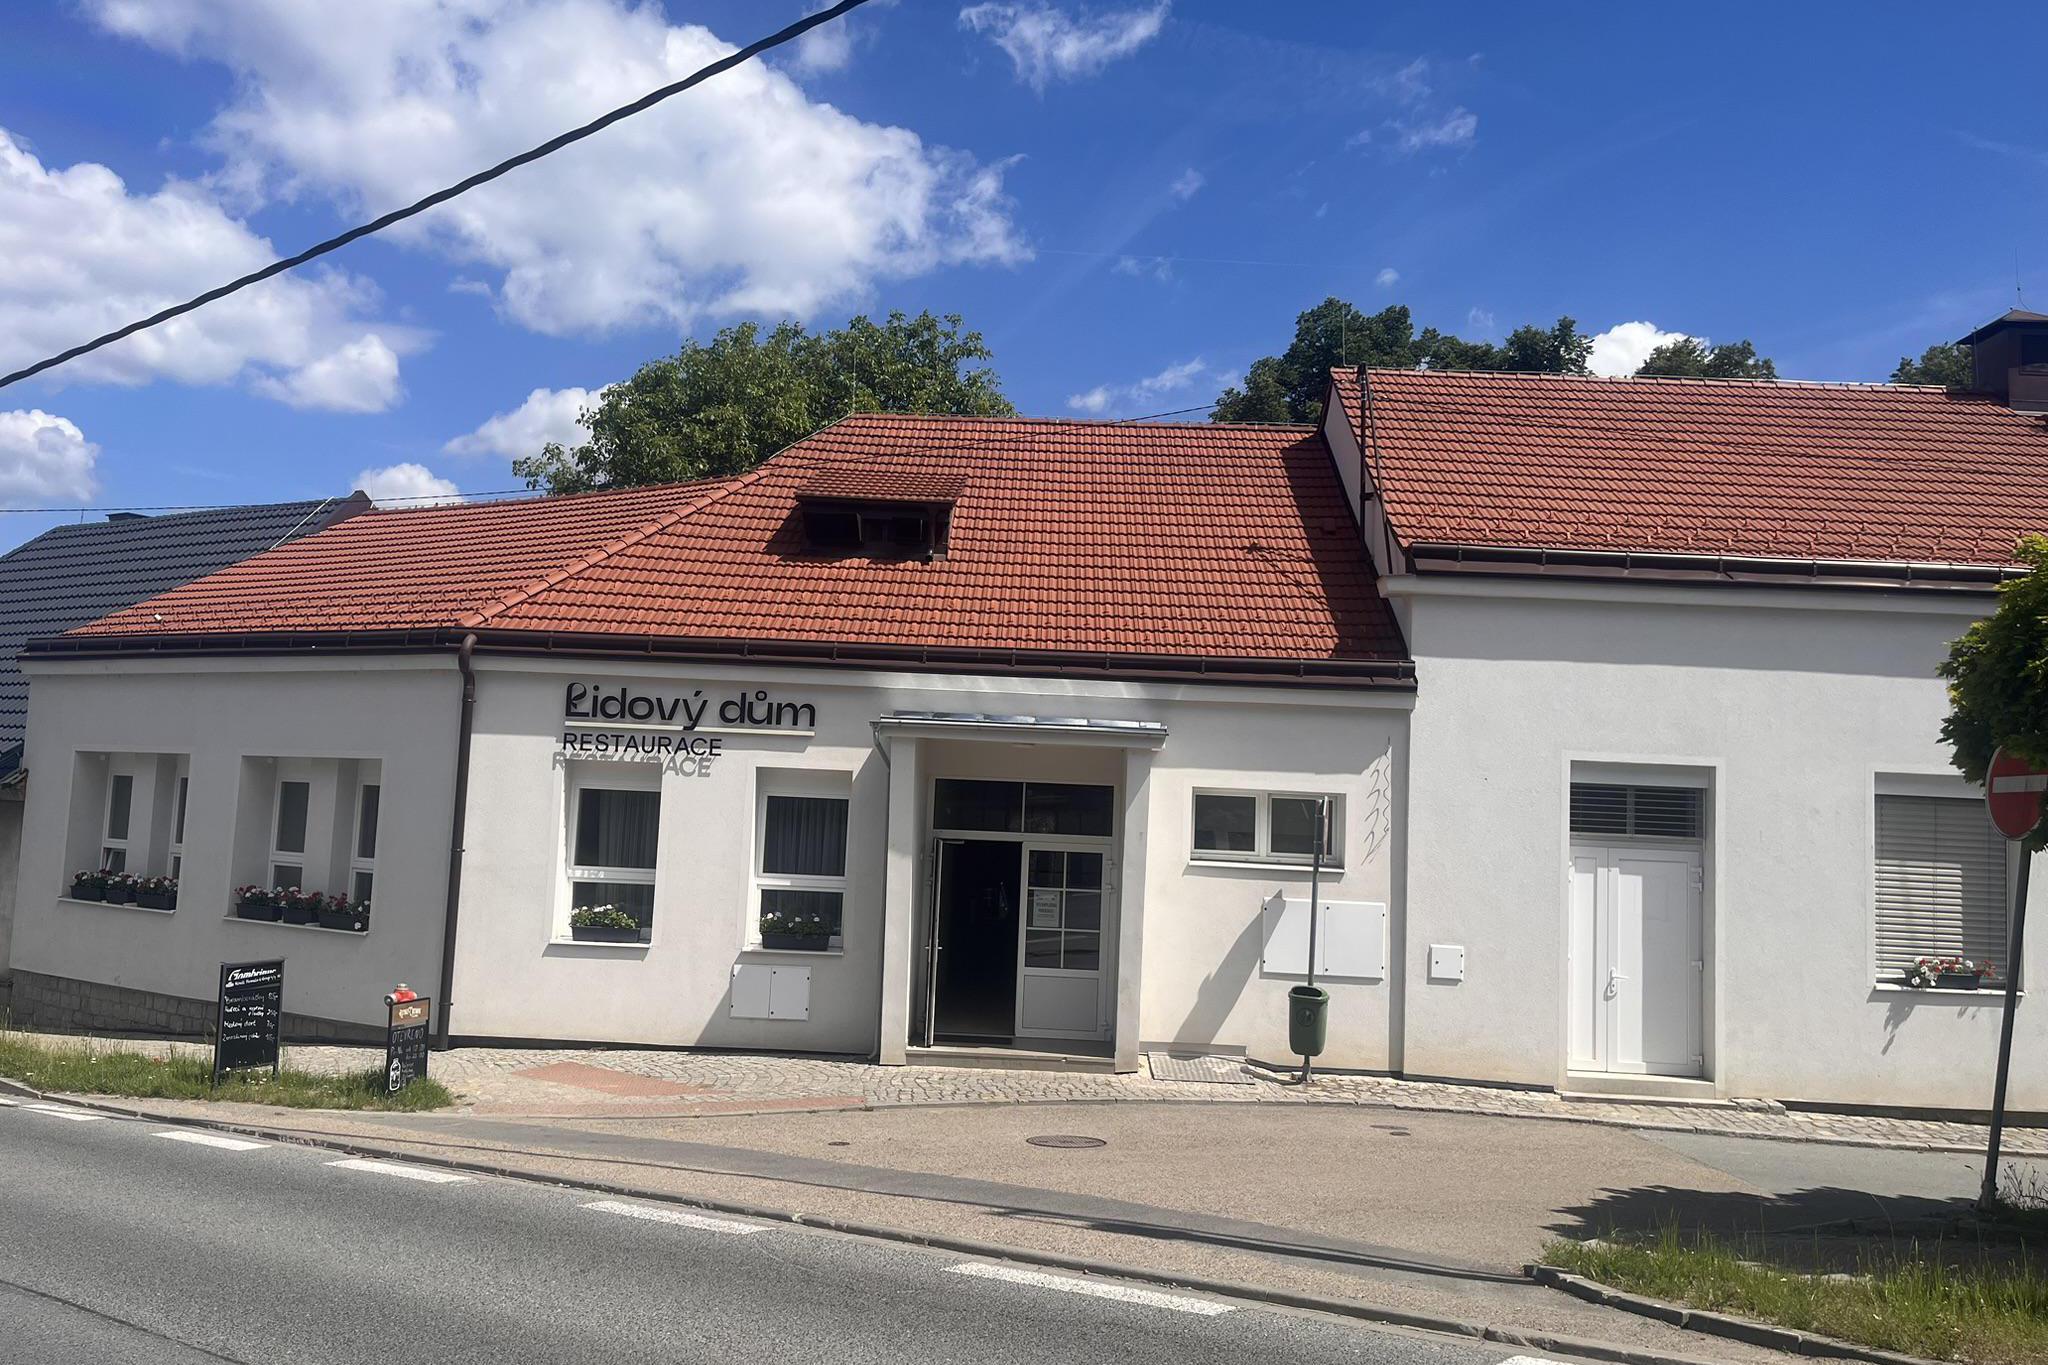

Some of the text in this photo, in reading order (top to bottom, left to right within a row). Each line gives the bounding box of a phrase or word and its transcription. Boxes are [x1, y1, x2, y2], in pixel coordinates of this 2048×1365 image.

[565, 682, 816, 731] Lidový dům
[563, 733, 722, 756] RESTAURACE
